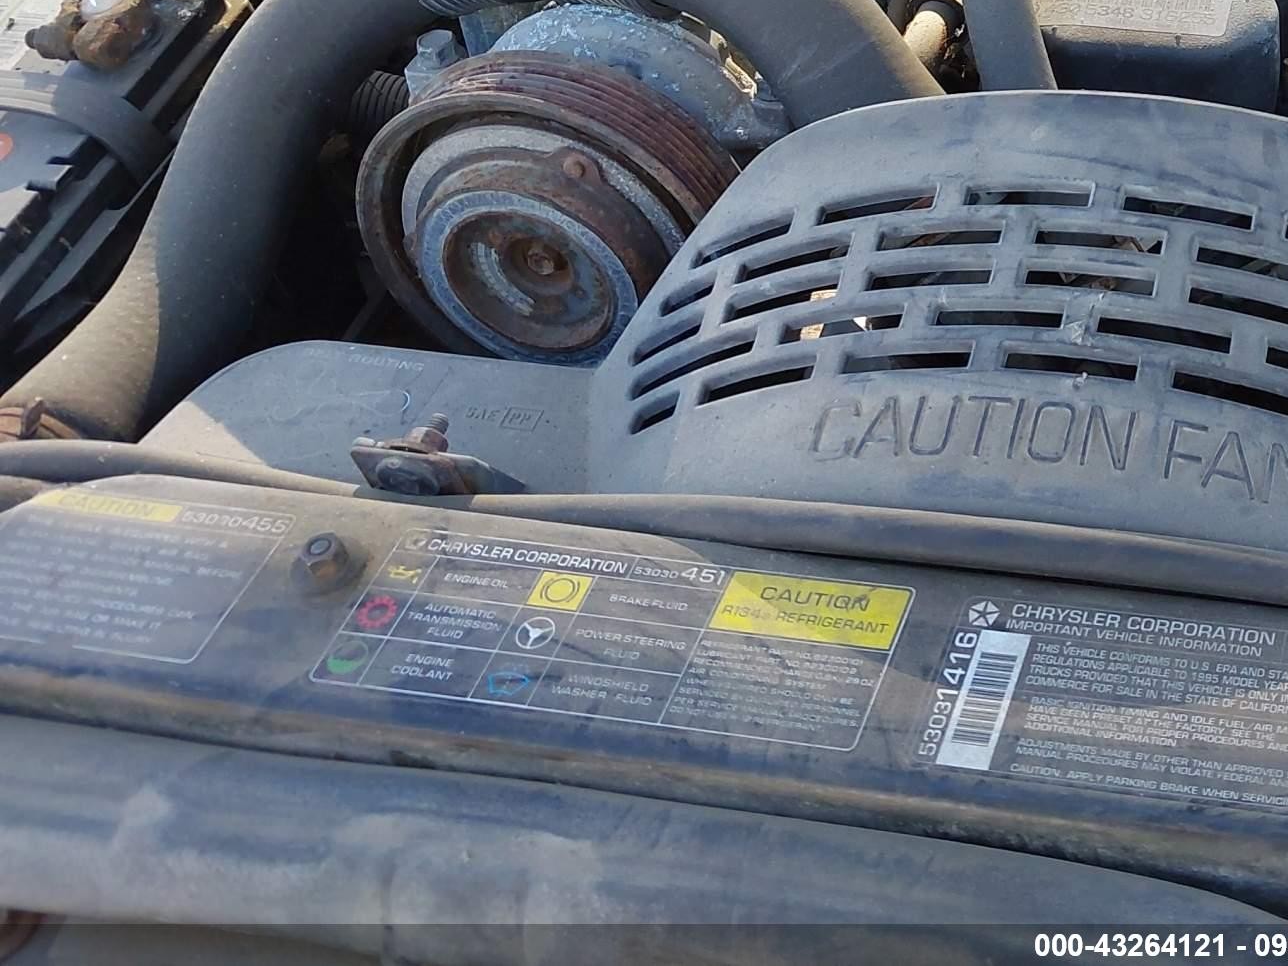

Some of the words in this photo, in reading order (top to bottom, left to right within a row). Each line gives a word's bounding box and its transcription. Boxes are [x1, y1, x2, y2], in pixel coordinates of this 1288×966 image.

[808, 395, 1139, 472] CAUTION
[57, 494, 156, 517] CAUTION
[427, 538, 514, 562] CHRYSLER
[514, 548, 628, 575] CORPORATION
[443, 572, 490, 588] ENGINE
[490, 577, 509, 589] OIL
[608, 593, 650, 607] BRAKE
[651, 599, 689, 612] FLUID
[759, 586, 872, 613] CAUTION
[407, 611, 502, 632] TRANSMISSION
[424, 602, 498, 620] AUTOMATIC
[775, 610, 890, 634] REFRIGERANT
[1011, 602, 1121, 628] CHRYSLER
[1126, 615, 1277, 647] CORPORATION
[425, 626, 464, 640] FLUID
[575, 627, 623, 642] POWER
[621, 634, 688, 651] STEERING
[1005, 618, 1092, 638] IMPORTANT
[1096, 628, 1155, 646] VEHICLE
[1159, 635, 1264, 658] INFORMATION
[405, 652, 456, 667] ENGINE
[603, 648, 641, 661] FLUID
[1032, 653, 1106, 672] REGULATIONS
[1106, 663, 1172, 679] APPLICABLE
[1173, 669, 1188, 680] TO
[1221, 675, 1261, 689] MODEL
[1036, 642, 1060, 655] THIS
[1063, 644, 1107, 660] VEHICLE
[1109, 650, 1171, 667] CONFORMS
[1174, 657, 1188, 669] TO
[1215, 663, 1238, 675] EPA
[1239, 666, 1266, 679] AND
[390, 664, 454, 682] COOLANT
[567, 674, 650, 693] WINDSHIELD
[1029, 663, 1073, 678] TRUCKS
[1073, 669, 1128, 684] PROVIDED
[1130, 675, 1159, 688] THAT
[1160, 679, 1186, 691] THIS
[1187, 682, 1234, 697] VEHICLE
[1234, 688, 1246, 699] IS
[1247, 689, 1279, 702] ONLY
[551, 684, 608, 700] WASHER
[614, 692, 653, 707] FLUID
[918, 631, 979, 757] 53031416
[1024, 674, 1091, 692] COMMERCE
[1091, 682, 1115, 695] FOR
[1115, 685, 1144, 698] SALE
[1145, 689, 1159, 700] IN
[1160, 690, 1184, 703] THE
[1184, 693, 1220, 708] STATE
[1221, 698, 1238, 708] OF
[1026, 713, 1073, 726] SERVICE
[1073, 717, 1119, 731] MANUAL
[1121, 723, 1145, 734] FOR
[1146, 727, 1189, 740] PROPER
[1191, 732, 1265, 749] PROCEDURES
[1028, 704, 1057, 716] HAVE
[1060, 708, 1090, 719] BEEN
[1092, 712, 1134, 724] PRESET
[1134, 717, 1151, 726] AT
[1150, 718, 1175, 730] THE
[1231, 728, 1252, 739] SEE
[1256, 730, 1276, 742] THE
[1030, 695, 1065, 708] BASIC
[1067, 700, 1116, 715] IGNITION
[1119, 707, 1161, 720] TIMING
[1161, 712, 1189, 723] AND
[1190, 715, 1217, 726] IDLE
[1219, 718, 1274, 733] FUEL/AIR
[1023, 721, 1093, 737] ADDITIONAL
[1095, 731, 1177, 747] INFORMATION
[1015, 745, 1062, 760] MANUAL
[1065, 752, 1139, 769] PROCEDURES
[1141, 761, 1168, 773] MAY
[1169, 764, 1214, 778] VIOLATE
[1217, 772, 1265, 786] FEDERAL
[1018, 737, 1098, 754] ADJUSTMENTS
[1101, 747, 1132, 759] MADE
[1135, 752, 1152, 761] BY
[1152, 754, 1190, 766] OTHER
[1191, 758, 1223, 770] THAN
[1224, 763, 1284, 778] APPROVED
[1066, 770, 1105, 783] APPLY
[1105, 775, 1158, 790] PARKING
[1159, 781, 1200, 795] BRAKE
[1202, 787, 1240, 801] WHEN
